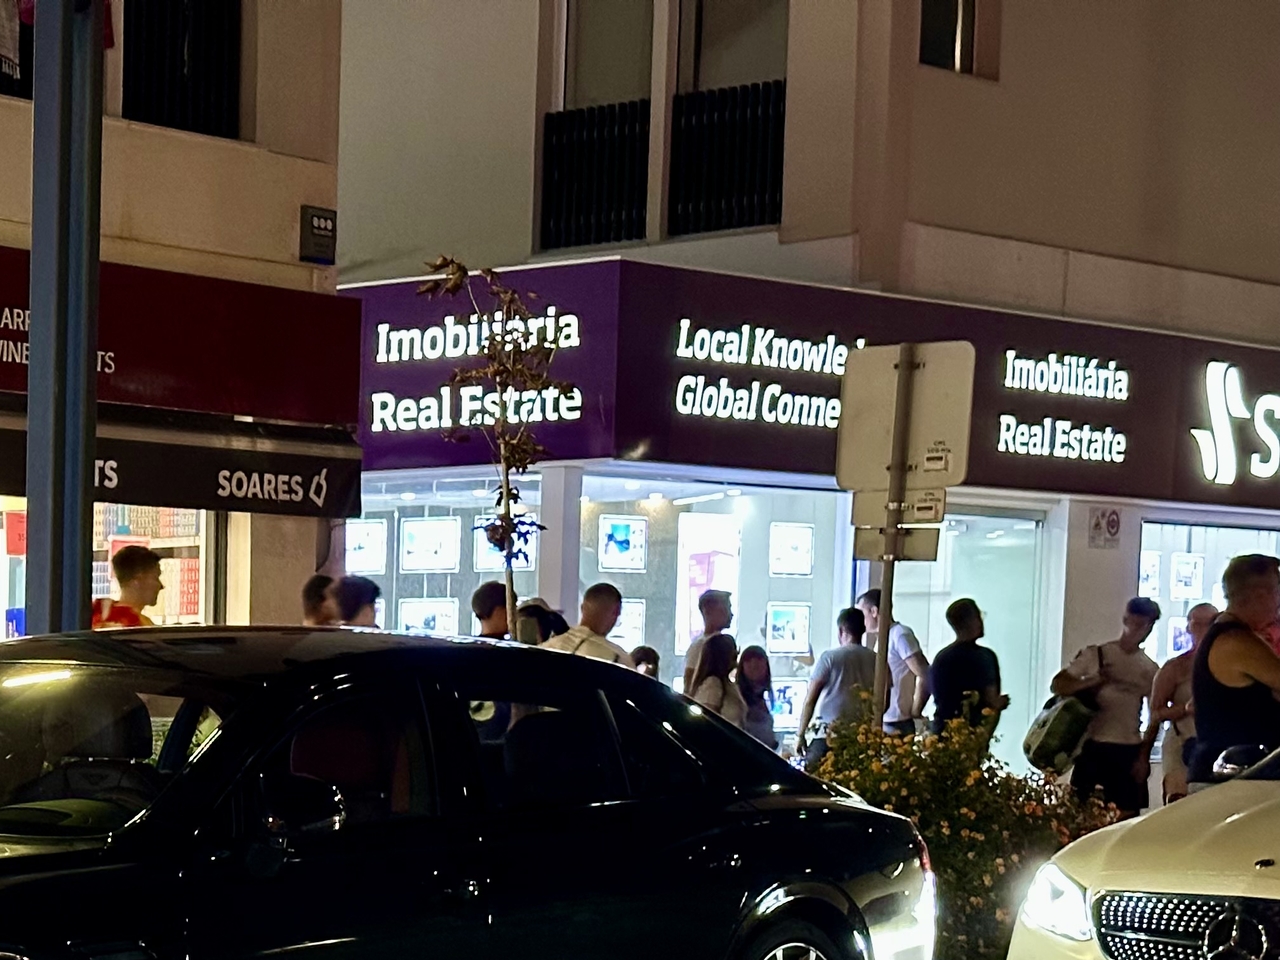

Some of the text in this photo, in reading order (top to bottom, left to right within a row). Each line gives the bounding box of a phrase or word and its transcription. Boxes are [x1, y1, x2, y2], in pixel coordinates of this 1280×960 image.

[676, 318, 866, 376] Local Knowle
[1005, 349, 1129, 401] Imobiliária
[371, 384, 583, 432] Real Estate
[676, 375, 841, 429] Global Conne
[998, 413, 1127, 464] Real Estate
[217, 469, 304, 502] SOARES
